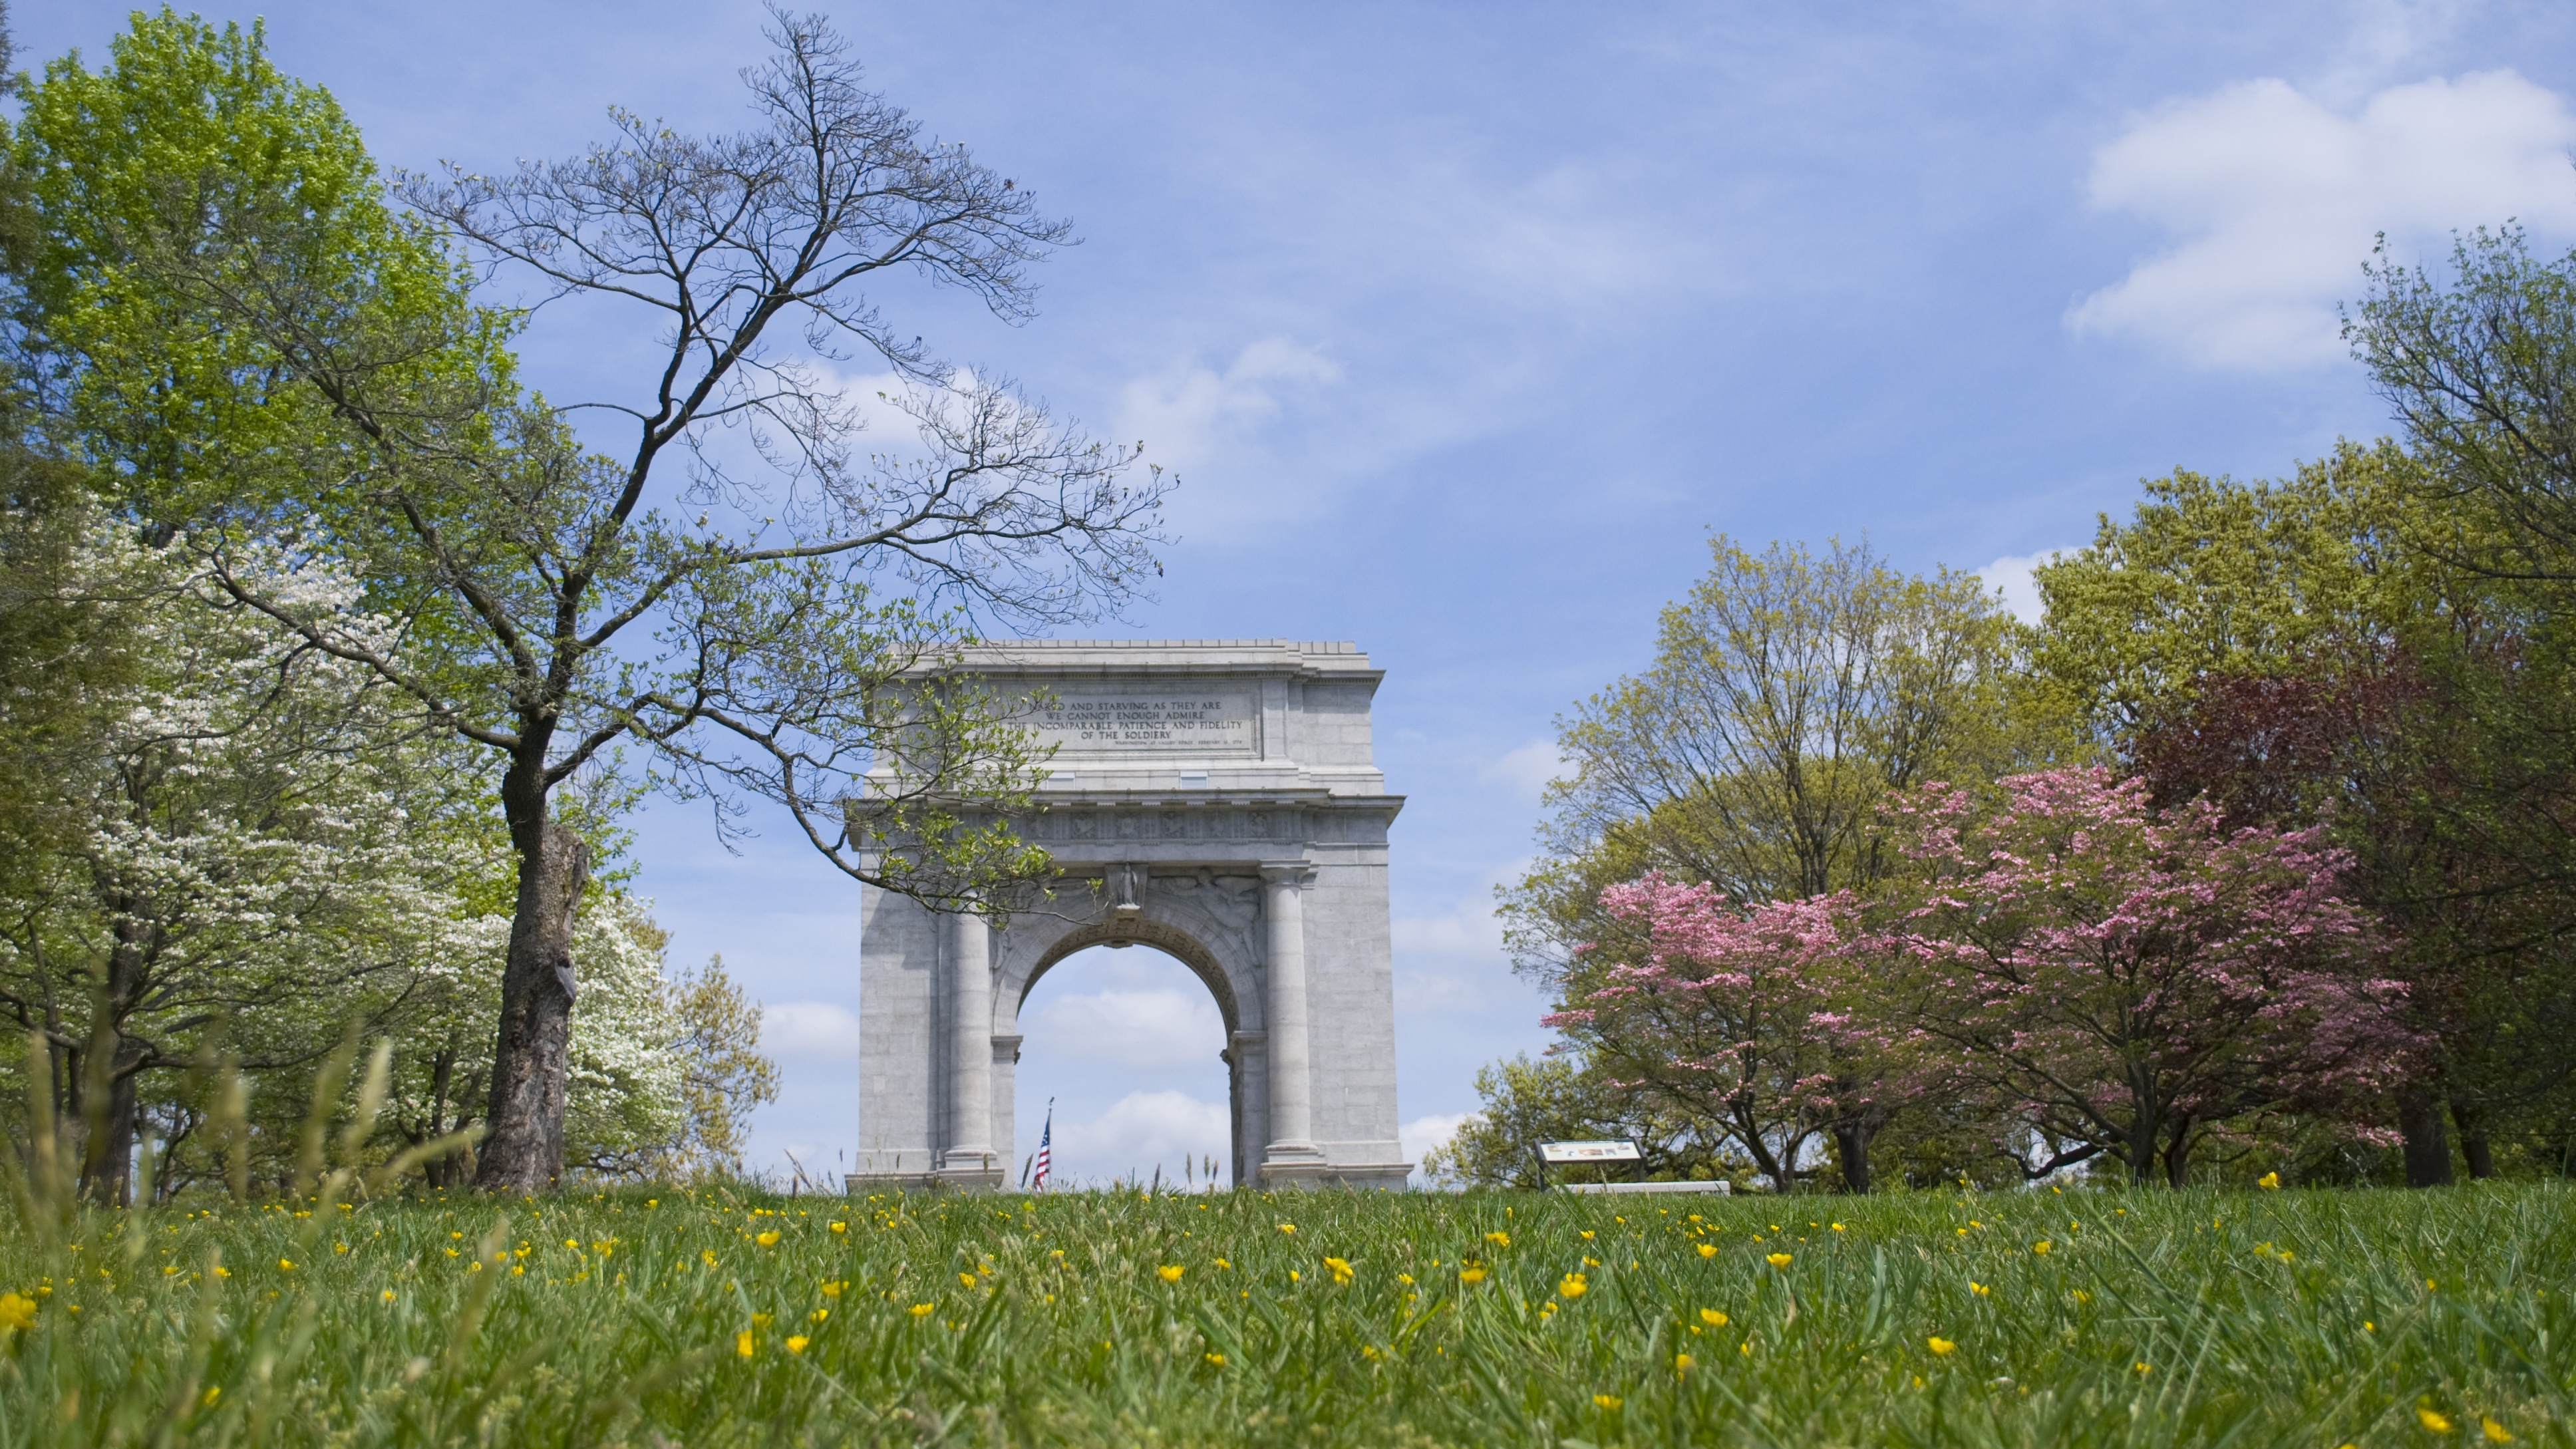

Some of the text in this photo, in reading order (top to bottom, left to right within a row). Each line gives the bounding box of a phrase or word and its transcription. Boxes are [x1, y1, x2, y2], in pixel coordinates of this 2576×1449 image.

[1009, 721, 1242, 730] THE INCOMPARABLE PATIENCE AND FIDELITY
